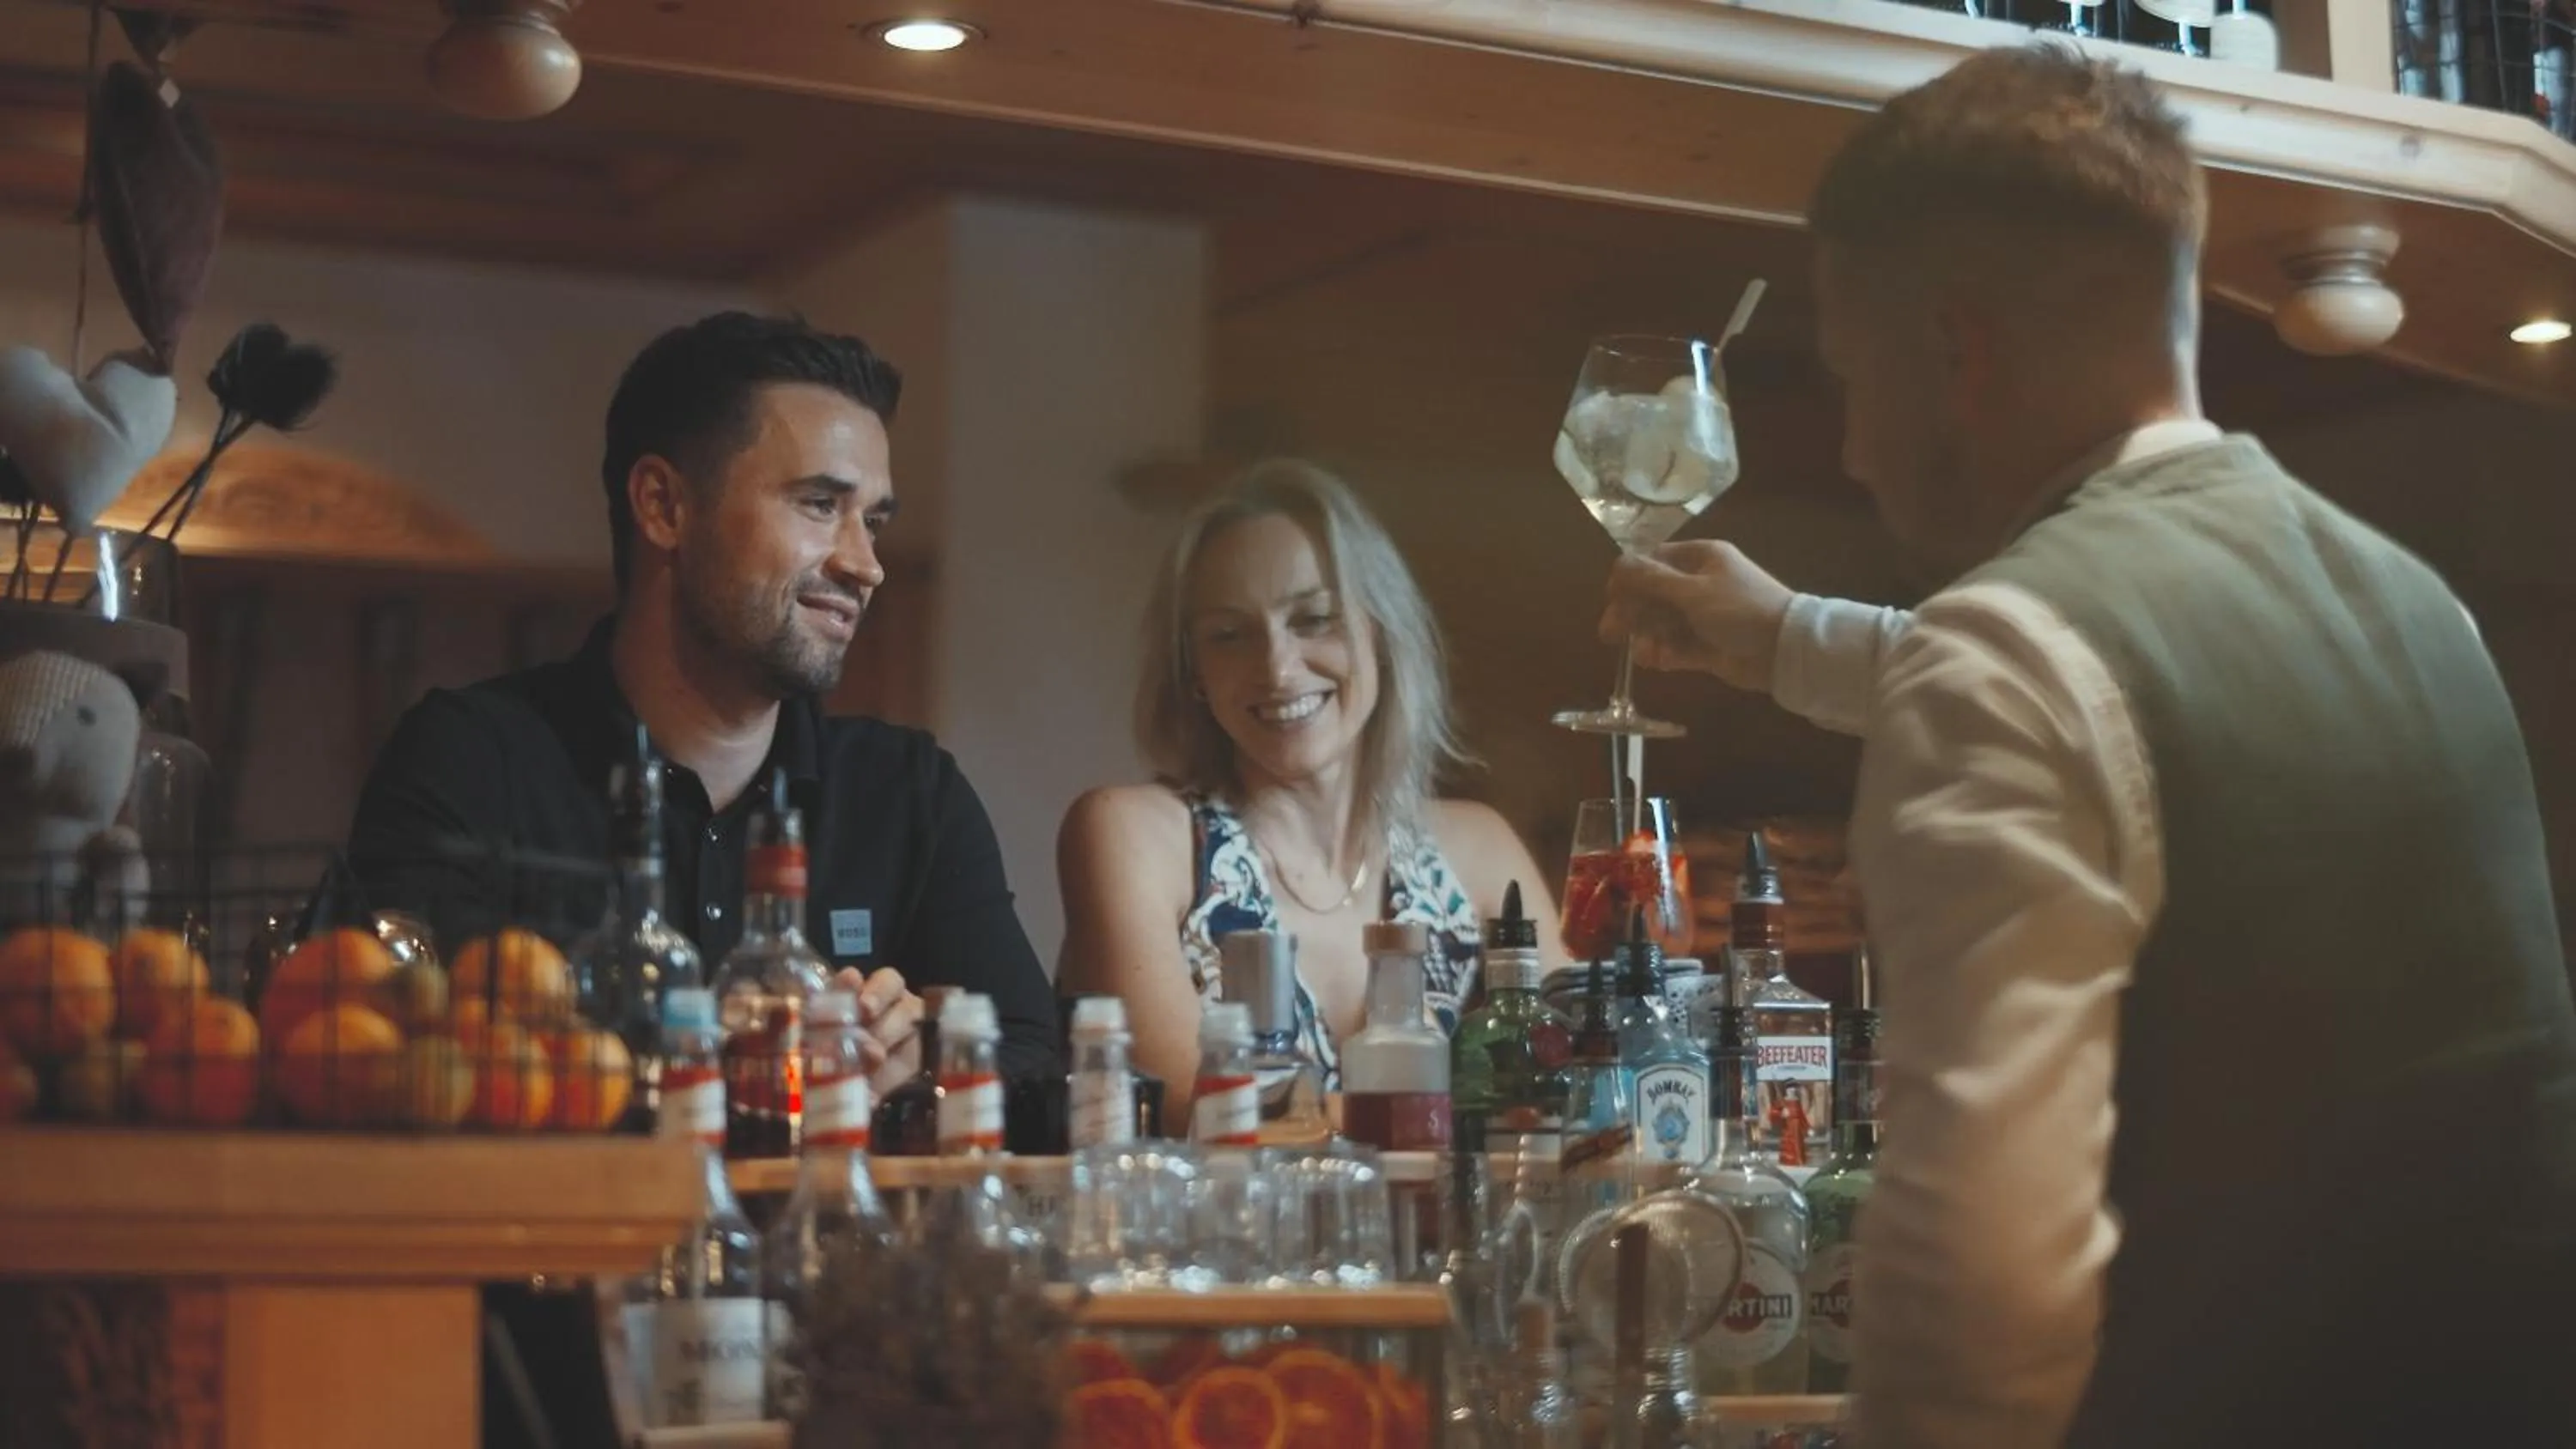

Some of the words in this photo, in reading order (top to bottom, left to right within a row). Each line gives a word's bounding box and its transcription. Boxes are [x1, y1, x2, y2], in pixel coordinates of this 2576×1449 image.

[1757, 1044, 1828, 1069] BEEFEATER
[1647, 1078, 1697, 1106] BOMBAY
[1727, 1294, 1792, 1319] RTINI
